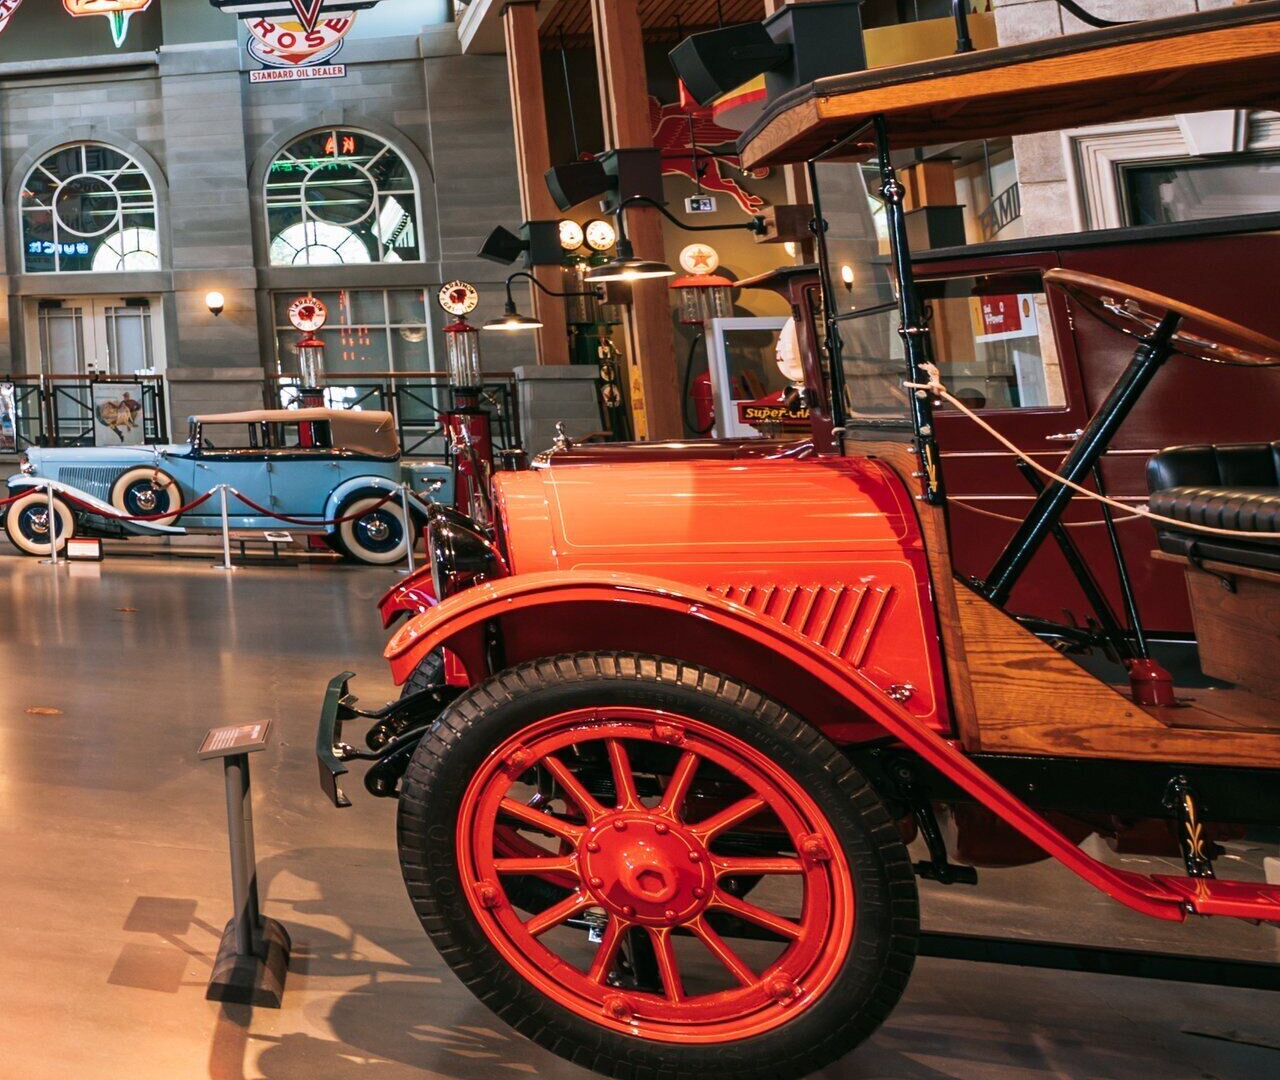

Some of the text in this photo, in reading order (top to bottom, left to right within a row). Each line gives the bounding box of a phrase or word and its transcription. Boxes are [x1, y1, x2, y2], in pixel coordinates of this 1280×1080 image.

[253, 18, 350, 49] ROSE
[251, 66, 344, 81] STANDARD OIL DEALER
